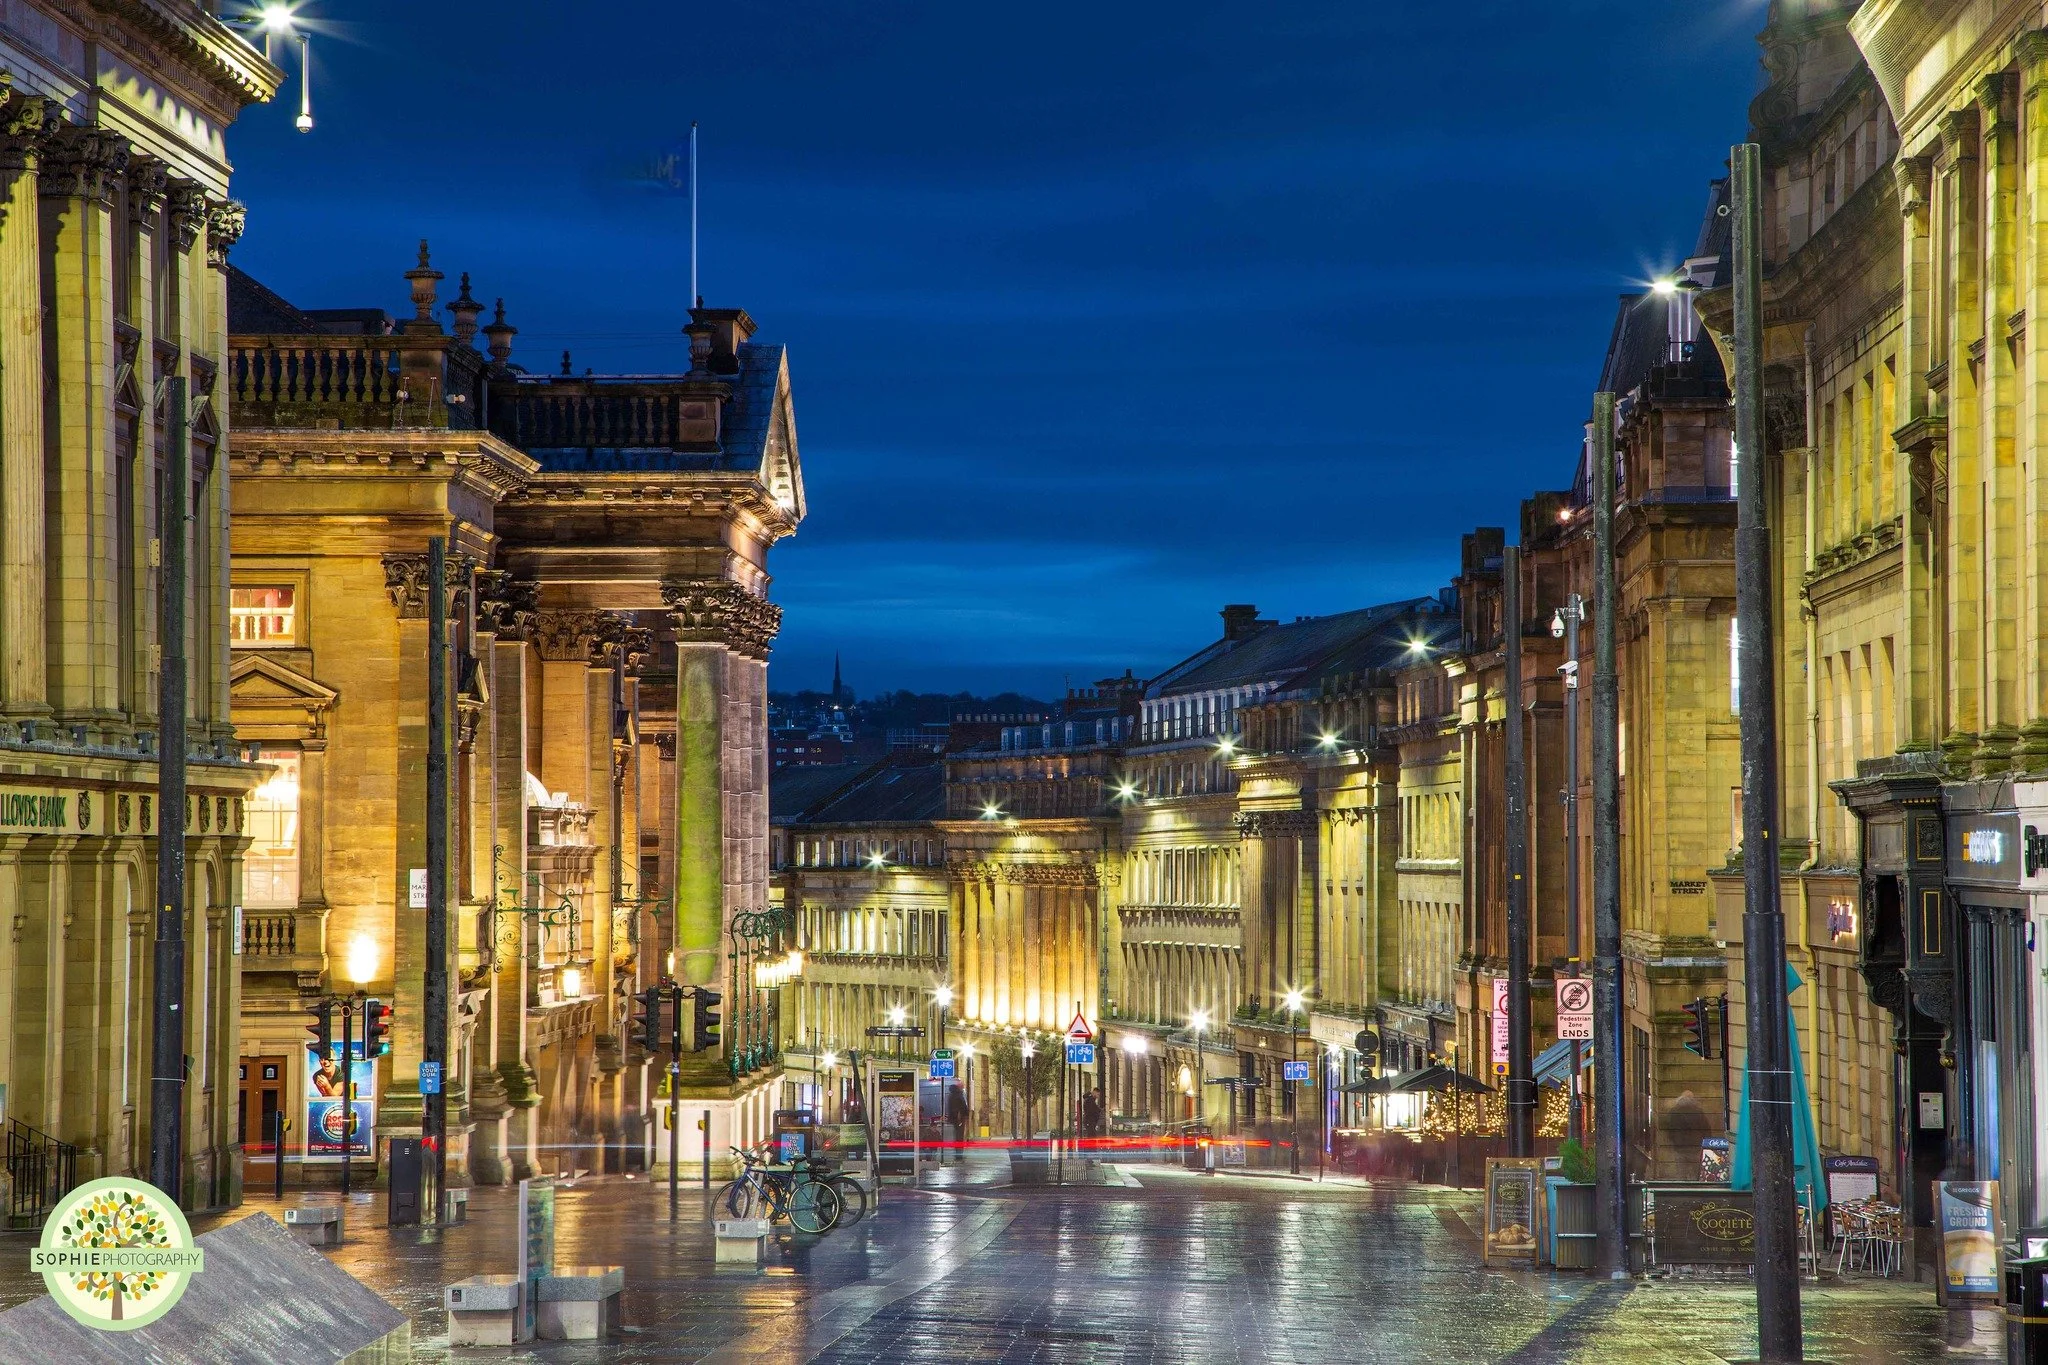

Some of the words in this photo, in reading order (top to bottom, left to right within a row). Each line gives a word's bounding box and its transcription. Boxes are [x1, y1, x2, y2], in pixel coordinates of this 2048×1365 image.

[1, 793, 38, 827] LLOYDS
[40, 795, 67, 828] BANK
[1562, 1029, 1589, 1038] ENDS
[1948, 1206, 1988, 1217] FRESHLY
[1950, 1216, 1988, 1227] GROUND
